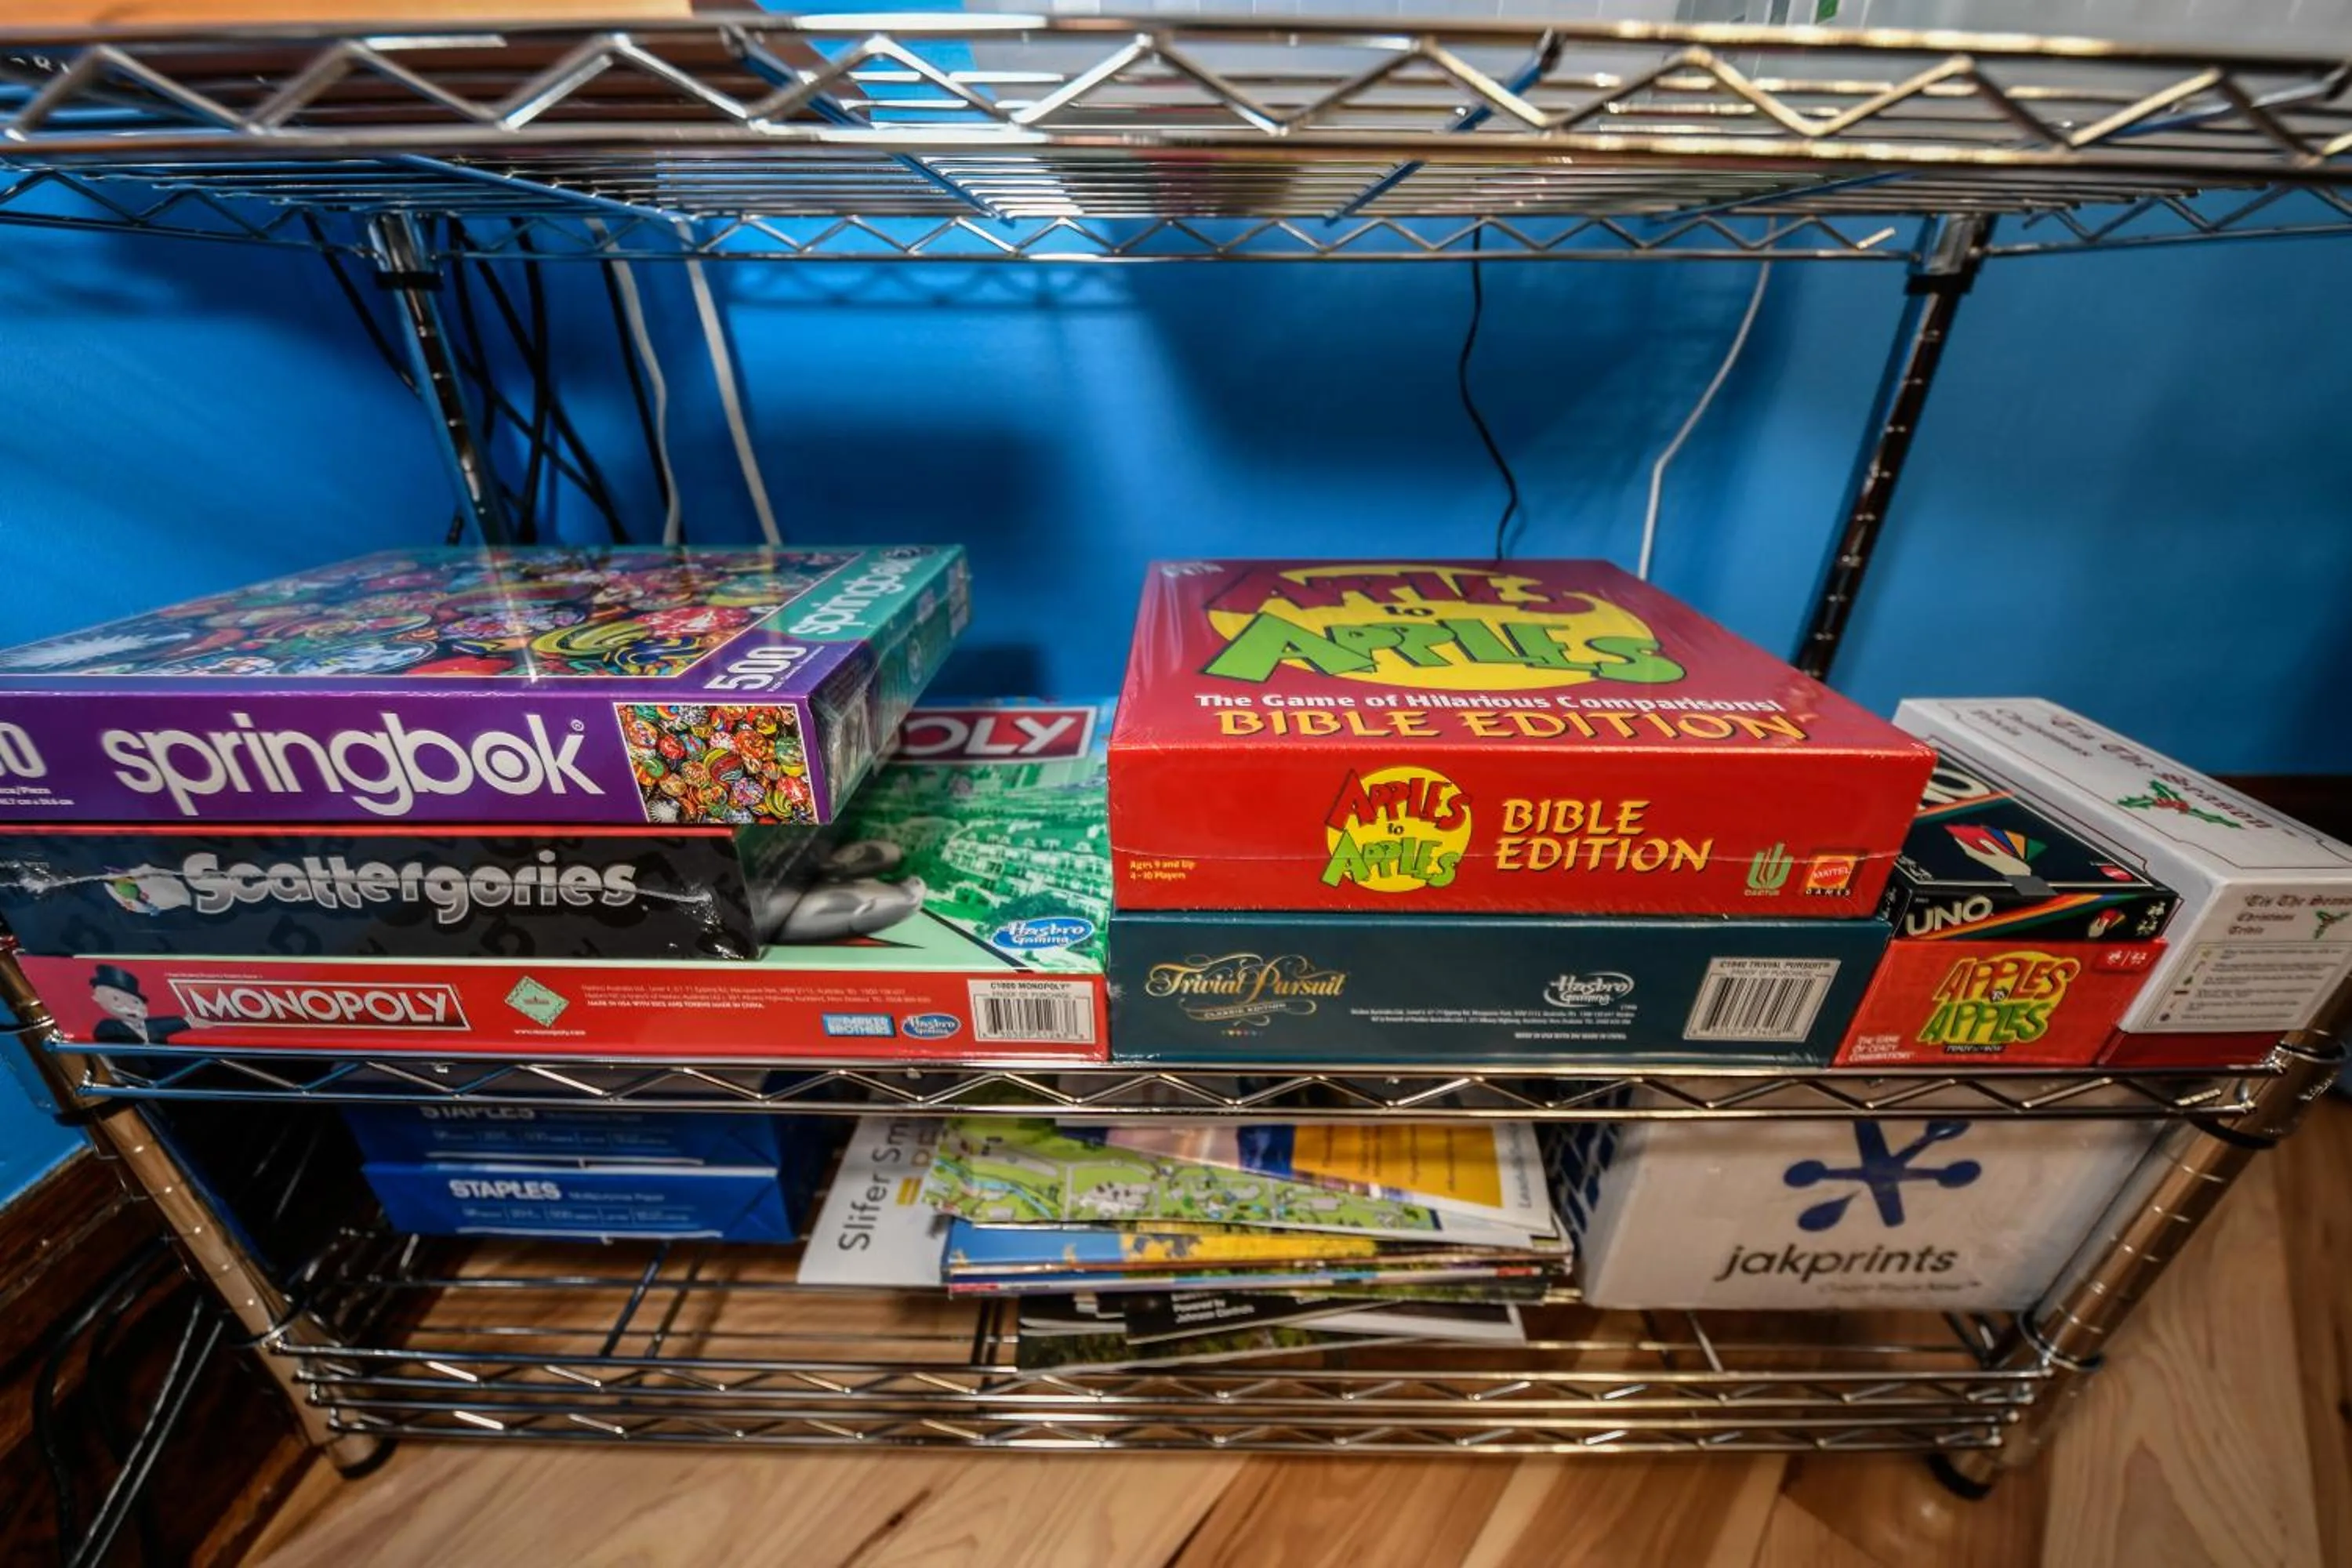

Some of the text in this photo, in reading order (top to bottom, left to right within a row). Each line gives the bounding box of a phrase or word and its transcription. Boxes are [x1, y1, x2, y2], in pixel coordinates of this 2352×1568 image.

[1197, 612, 1687, 683] APPLES
[703, 646, 807, 691] 500
[1194, 694, 1787, 713] The Game of Hilarious Comparisons!
[1216, 710, 1810, 742] BIBLE EDITION
[1324, 768, 1473, 829] APPLES
[1501, 799, 1651, 836] BIBLE
[1387, 822, 1405, 836] to
[1321, 829, 1461, 888] APPLES
[1494, 837, 1715, 873] EDITION
[183, 851, 637, 925] Scattergories
[1005, 920, 1085, 936] Hasbro
[1906, 895, 1993, 936] UNO
[1145, 953, 1347, 1003] Trivial Pursuit
[1549, 975, 1630, 995] Hasbro
[1932, 956, 2082, 1001] APPLES
[187, 987, 448, 1023] MONOPOLY
[908, 1015, 956, 1029] Hasbro
[1916, 1001, 2049, 1044] APPLES
[449, 1179, 562, 1200] STAPLES
[839, 1167, 892, 1251] Slifer
[1714, 1243, 1959, 1283] jakprints
